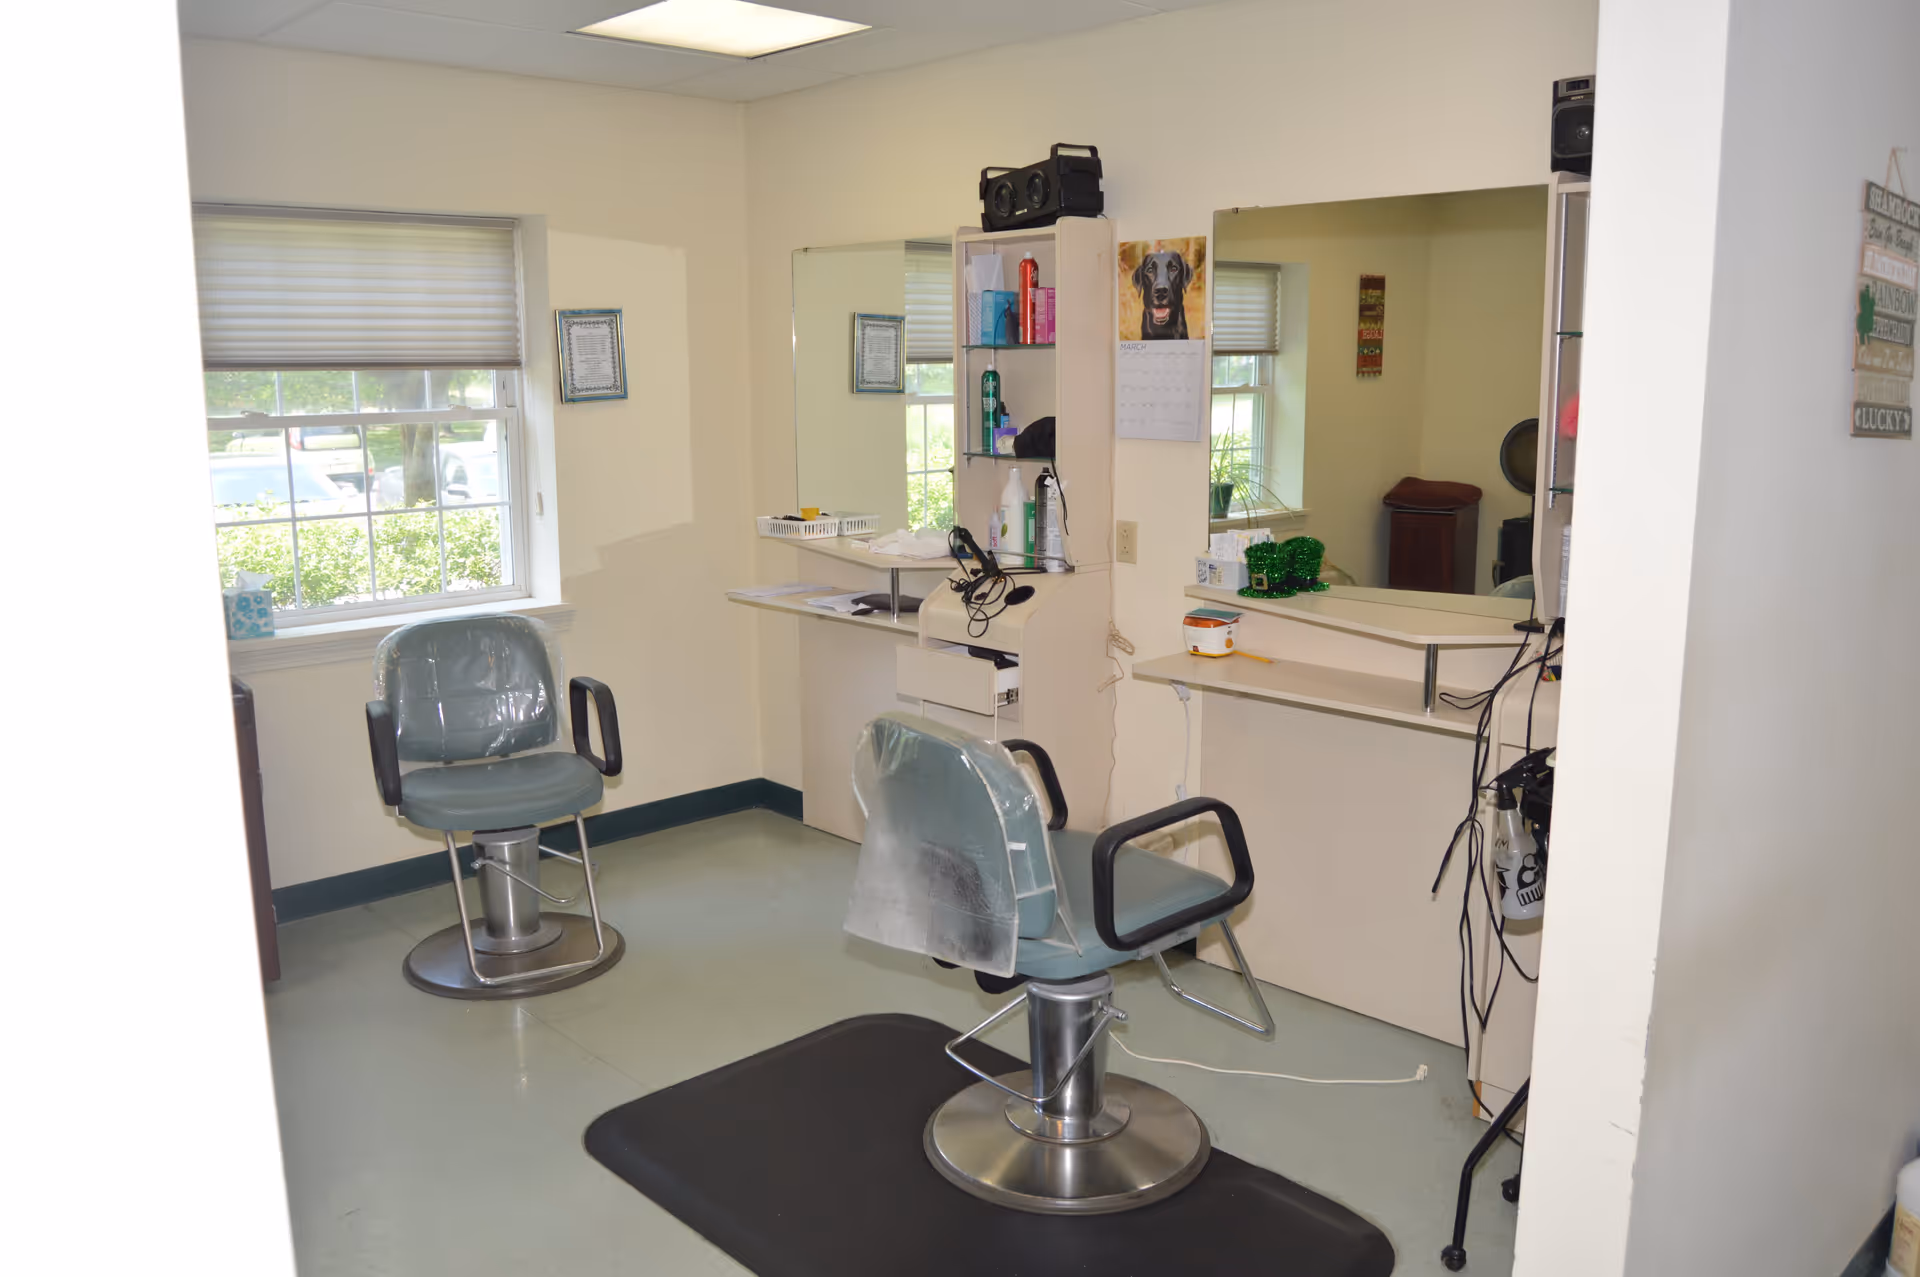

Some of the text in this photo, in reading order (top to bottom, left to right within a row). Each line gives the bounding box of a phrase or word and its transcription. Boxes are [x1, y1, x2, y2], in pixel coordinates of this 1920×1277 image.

[1870, 281, 1918, 314] RAINBOW
[1119, 343, 1147, 351] MARCH
[1862, 407, 1902, 431] LUCKY
